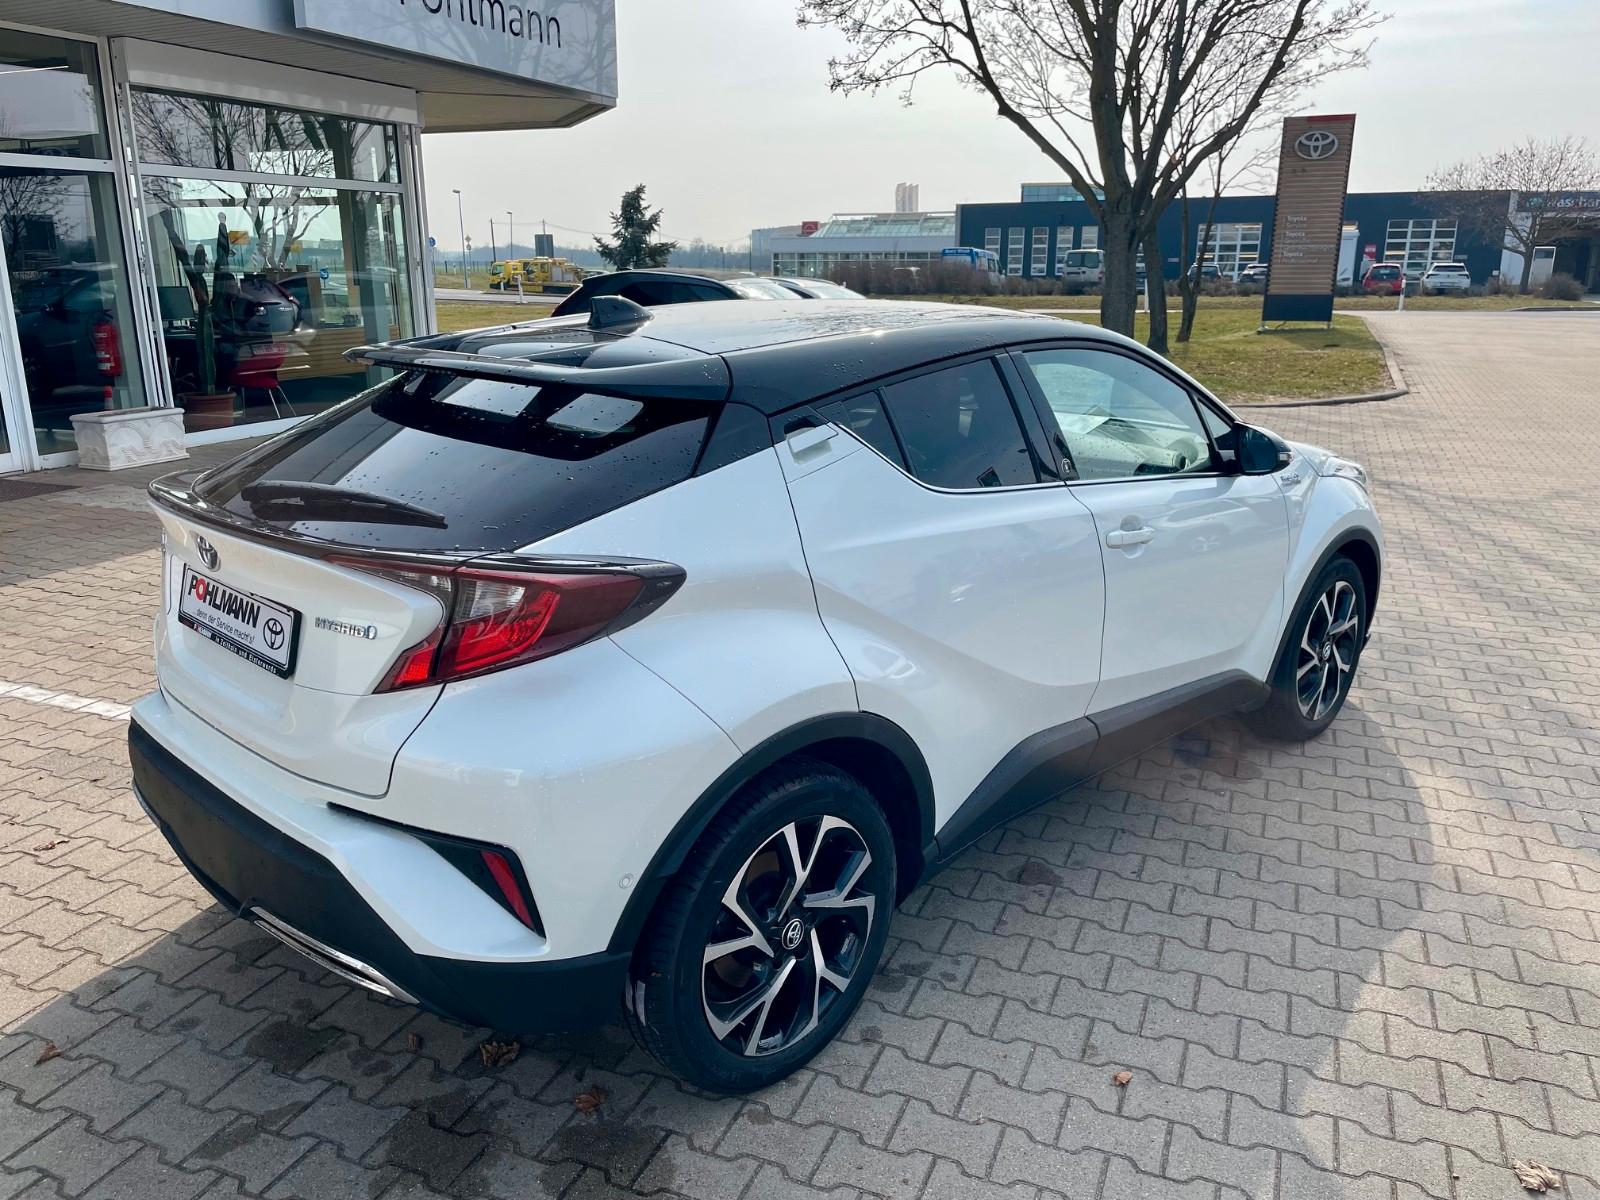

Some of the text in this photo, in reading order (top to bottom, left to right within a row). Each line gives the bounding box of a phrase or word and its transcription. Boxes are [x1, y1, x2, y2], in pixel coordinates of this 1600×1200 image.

[400, 0, 561, 48] lmann
[1285, 231, 1306, 239] Toyota
[188, 574, 261, 629] POHLMANN
[208, 612, 217, 625] der
[216, 615, 234, 634] Service
[314, 616, 367, 638] HYBRID
[238, 648, 248, 660] und
